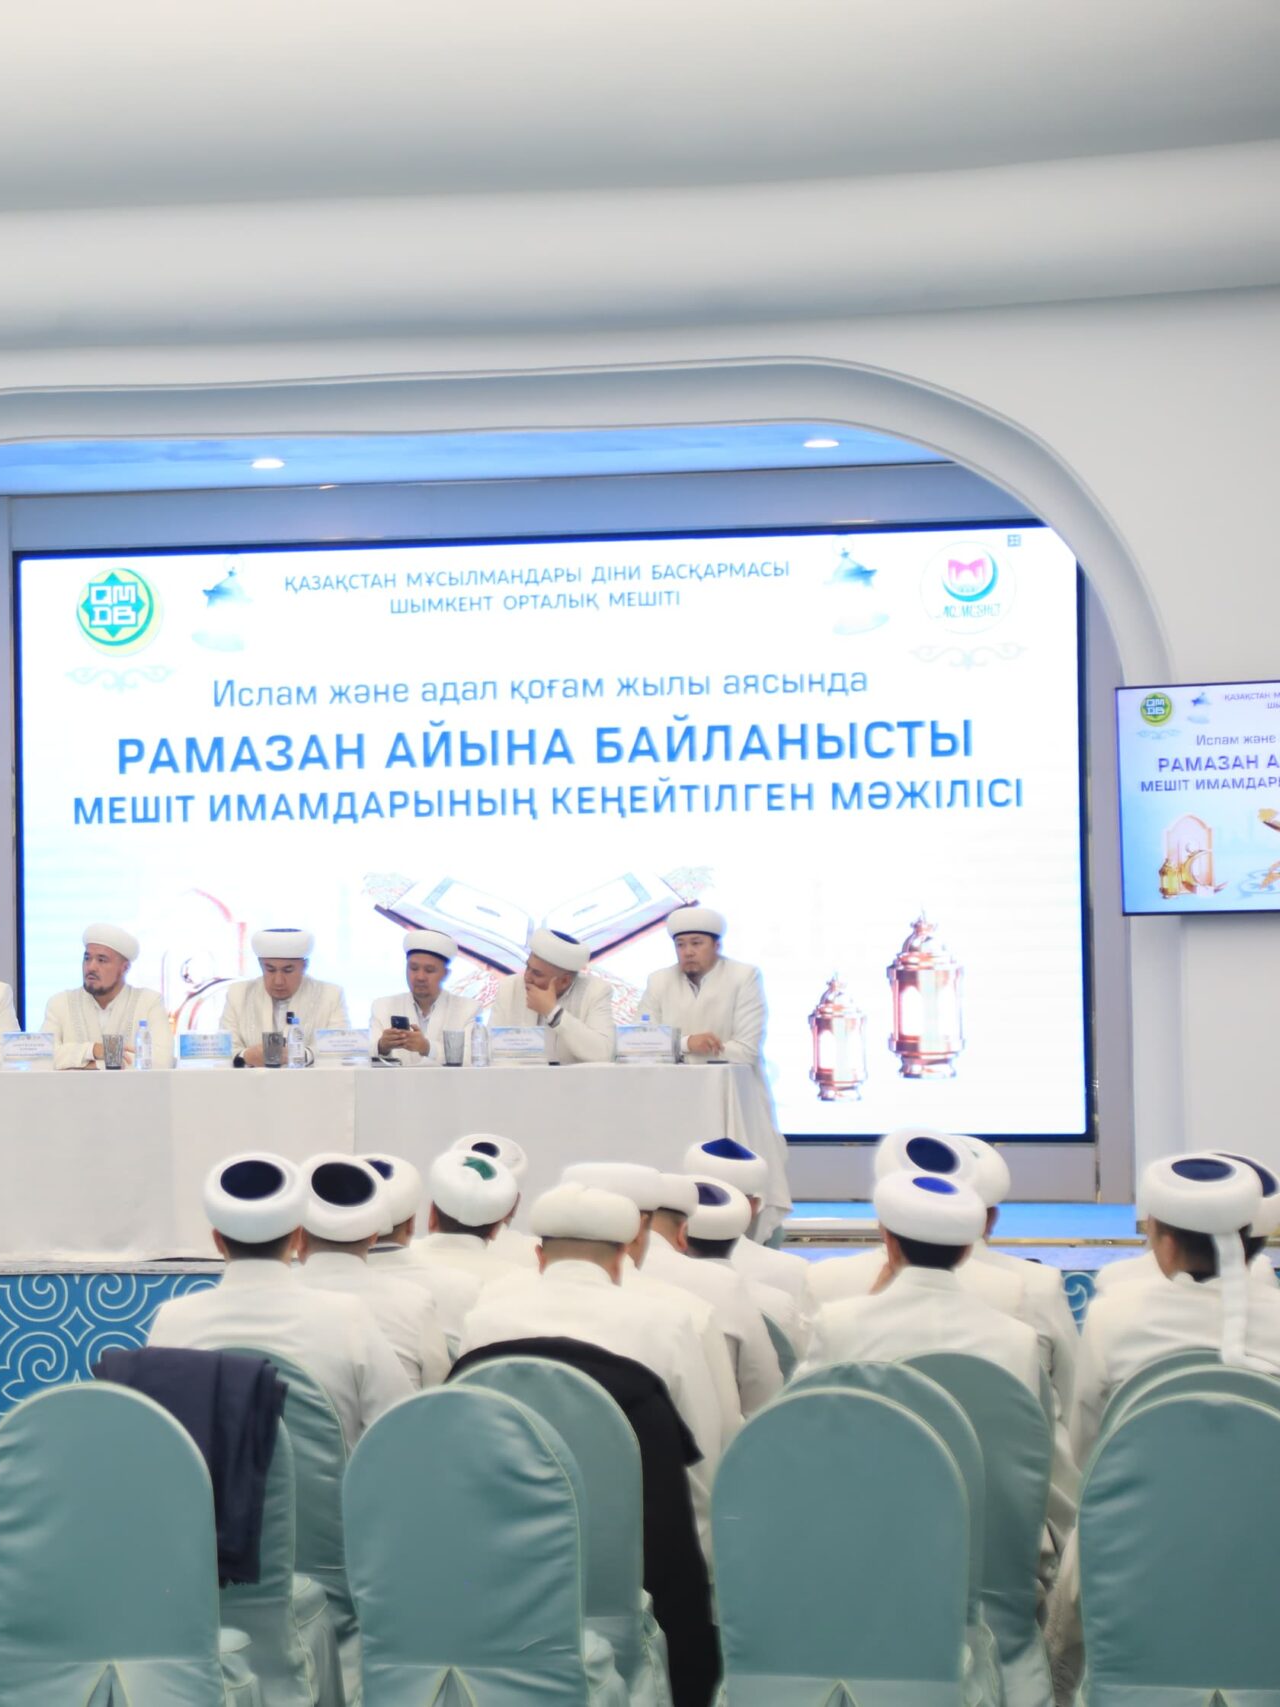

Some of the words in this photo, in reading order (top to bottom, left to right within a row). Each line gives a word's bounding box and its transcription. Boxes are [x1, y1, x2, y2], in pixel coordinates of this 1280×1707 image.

[285, 573, 396, 595] ҚАЗАҚСТАН
[406, 567, 582, 588] МҰСЫЛМАНДАРЫ
[591, 565, 641, 586] ДІНИ
[651, 560, 790, 582] БАСҚАРМАСЫ
[389, 595, 493, 615] ШЫМКЕНТ
[503, 592, 600, 613] ОРТАЛЫҚ
[608, 589, 681, 609] МЕШІТІ
[214, 679, 318, 709] Ислам
[328, 682, 410, 706] және
[420, 679, 498, 705] адал
[510, 678, 605, 705] қоғам
[616, 675, 711, 699] жылы
[722, 672, 868, 699] аясында
[118, 733, 365, 776] РАМАЗАН
[384, 720, 575, 769] АЙЫНА
[595, 714, 973, 764] БАЙЛАНЫСТЫ
[1196, 734, 1240, 746] Ислам
[1243, 735, 1277, 746] және
[1158, 754, 1259, 773] РАМАЗАН
[1140, 779, 1190, 793] МЕШІТ
[1195, 776, 1280, 792] ИМАМДАР
[73, 795, 196, 826] МЕШІТ
[209, 787, 539, 826] ИМАМДАРЫНЫҢ
[551, 777, 814, 820] КЕҢЕЙТІЛГЕН
[831, 776, 1023, 812] МӘЖІЛІСІ
